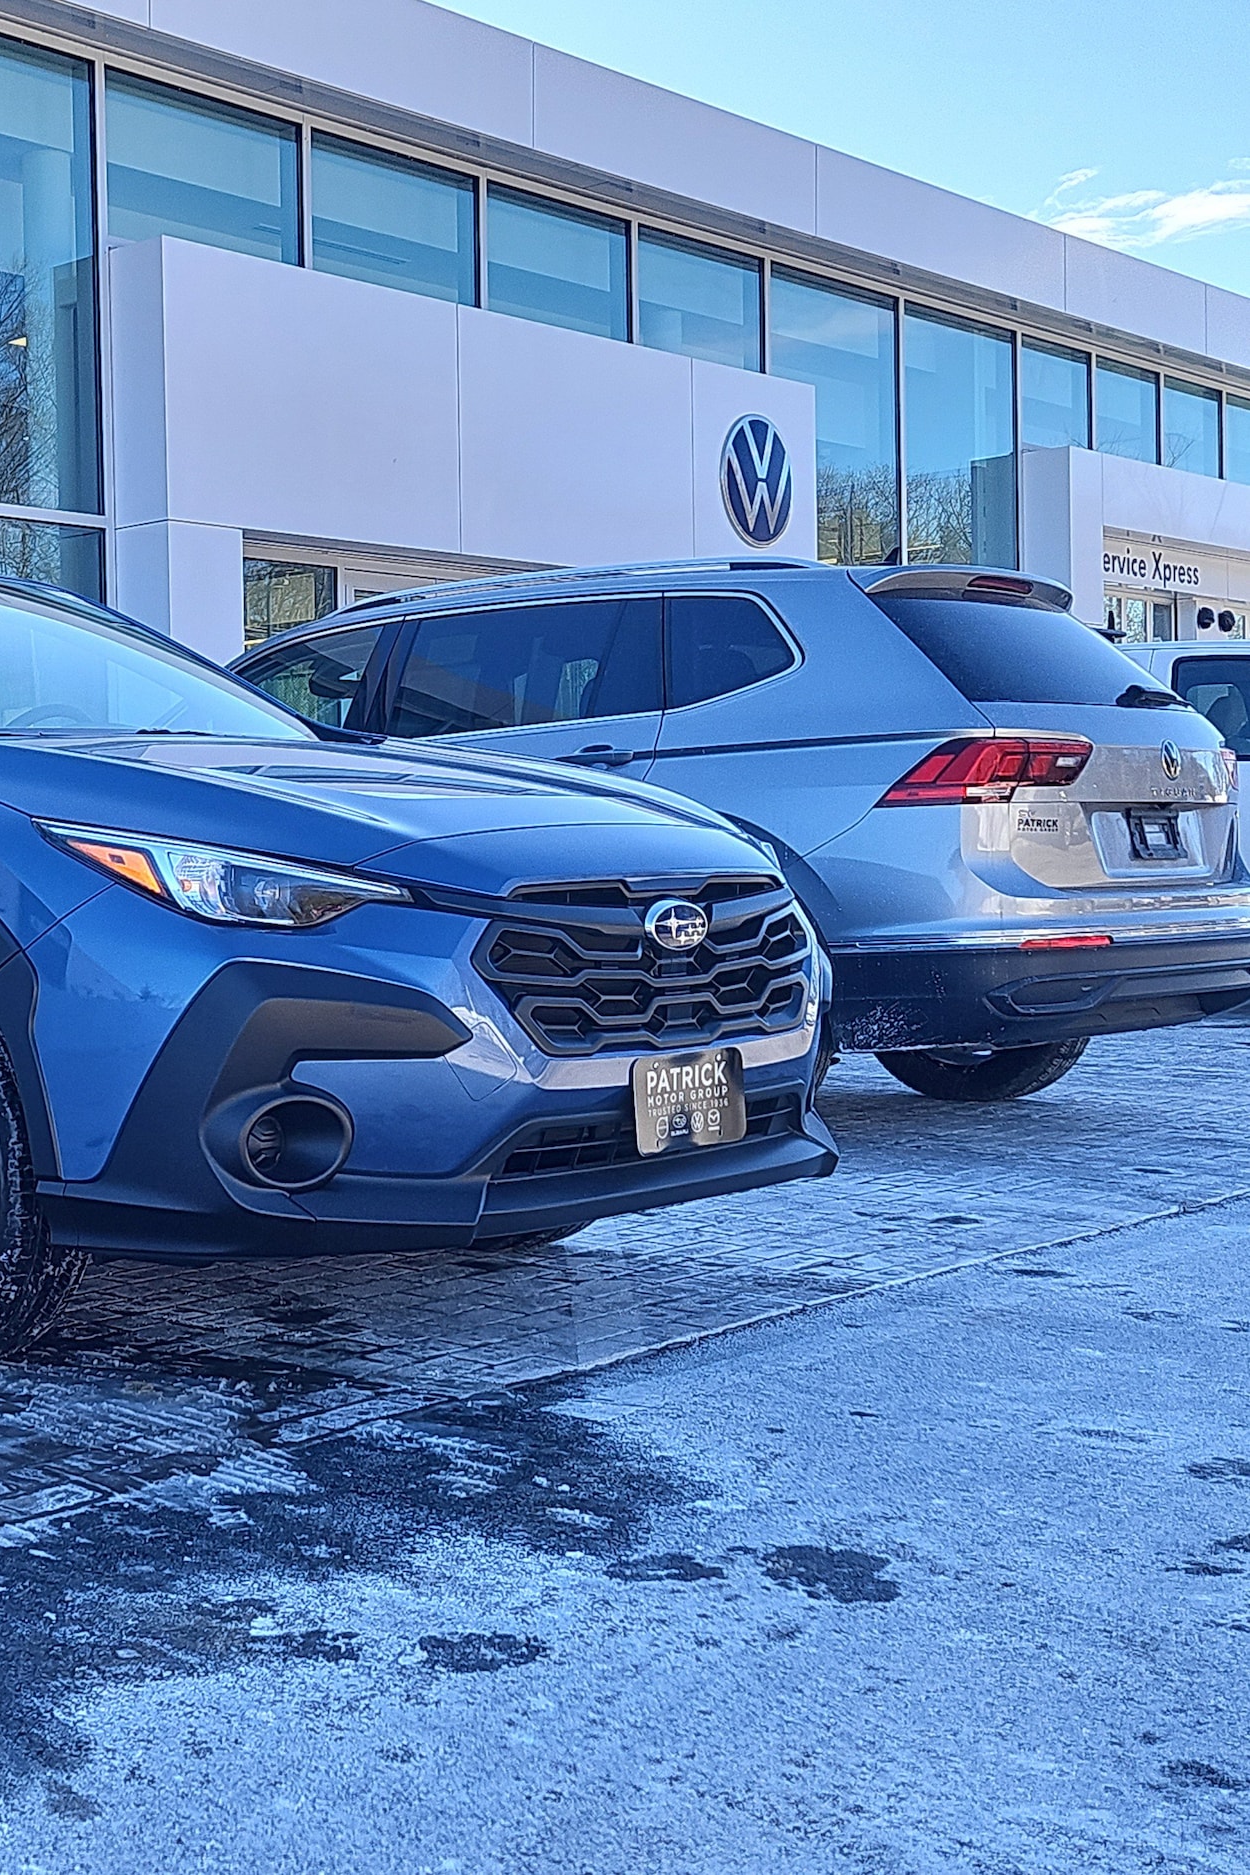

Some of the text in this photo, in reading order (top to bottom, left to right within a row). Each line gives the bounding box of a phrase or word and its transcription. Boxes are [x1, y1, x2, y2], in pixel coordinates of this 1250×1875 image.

[1103, 547, 1200, 588] ervice Xpress
[1017, 818, 1059, 828] PATRICK
[647, 1061, 727, 1095] PATRICK
[647, 1085, 728, 1108] MOTOR GROUP
[648, 1105, 681, 1117] TRUSTED
[684, 1100, 707, 1112] SINCE
